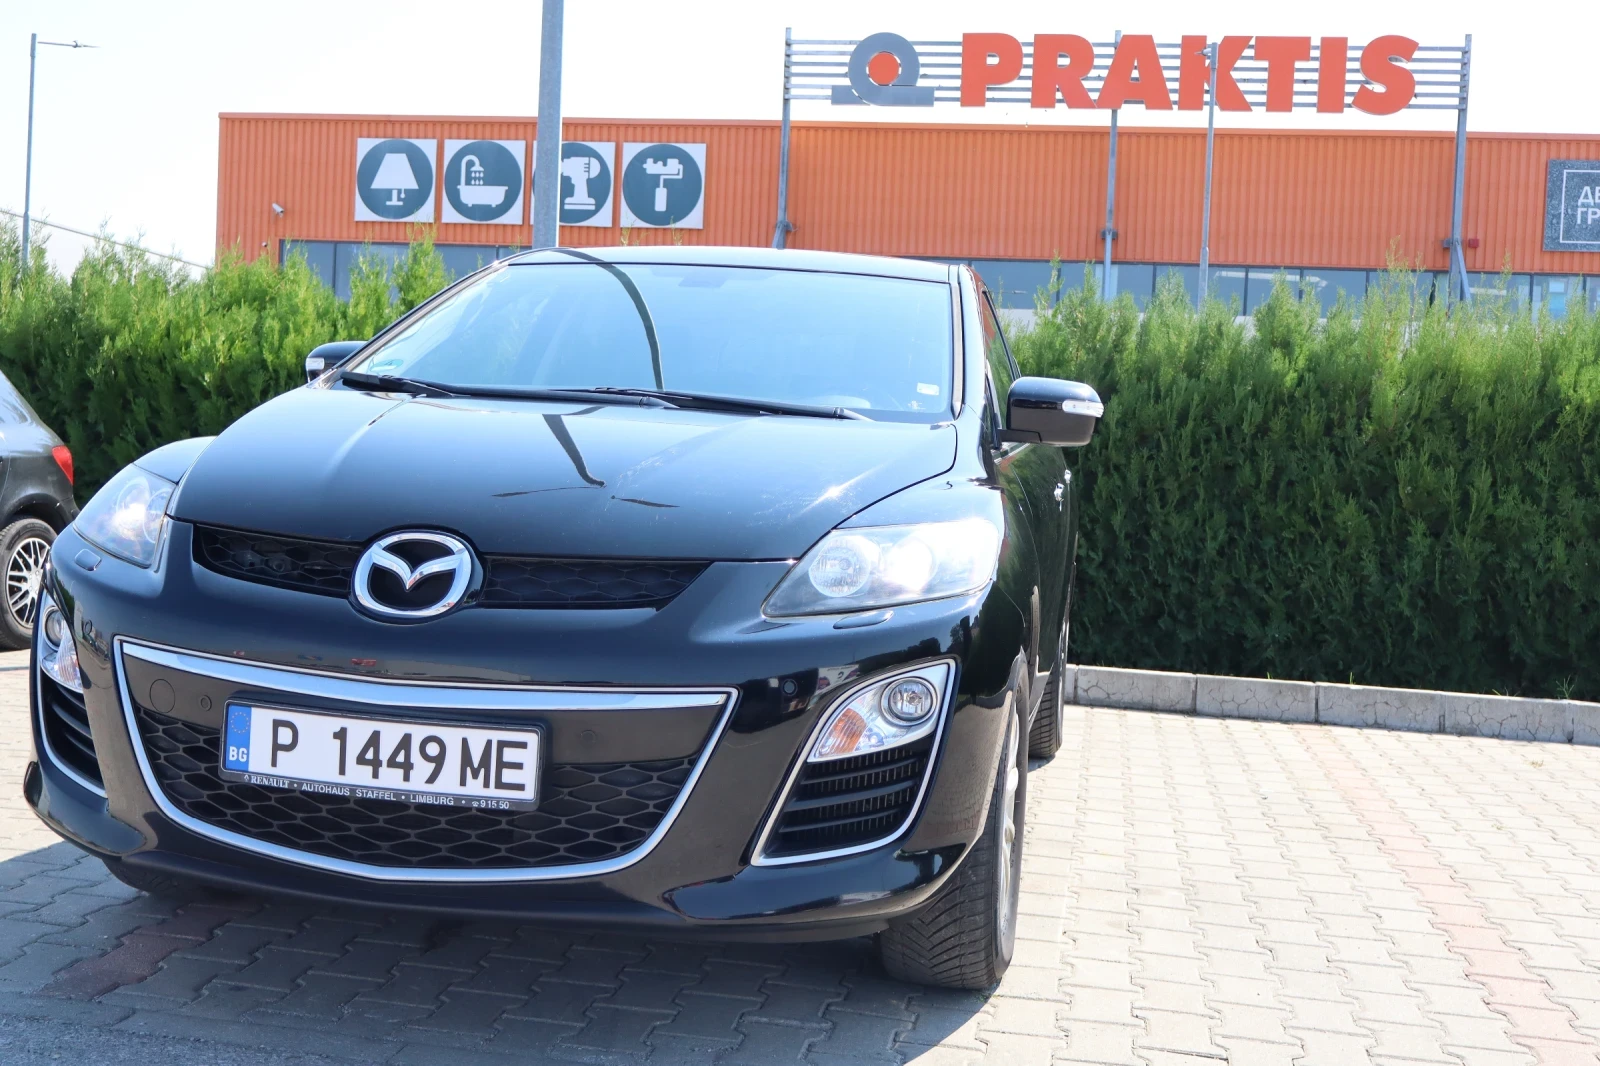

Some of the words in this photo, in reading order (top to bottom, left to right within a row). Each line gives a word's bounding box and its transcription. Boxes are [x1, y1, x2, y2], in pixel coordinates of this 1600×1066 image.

[960, 32, 1419, 116] PRAKTIS
[229, 746, 248, 762] BG
[271, 718, 299, 768] P
[332, 726, 447, 785] 1449
[459, 737, 528, 792] ME
[251, 775, 290, 789] RENAULT
[301, 782, 351, 796] AUTOHAUS
[355, 789, 397, 801] STAFFEL
[410, 794, 454, 806] LIMBURG
